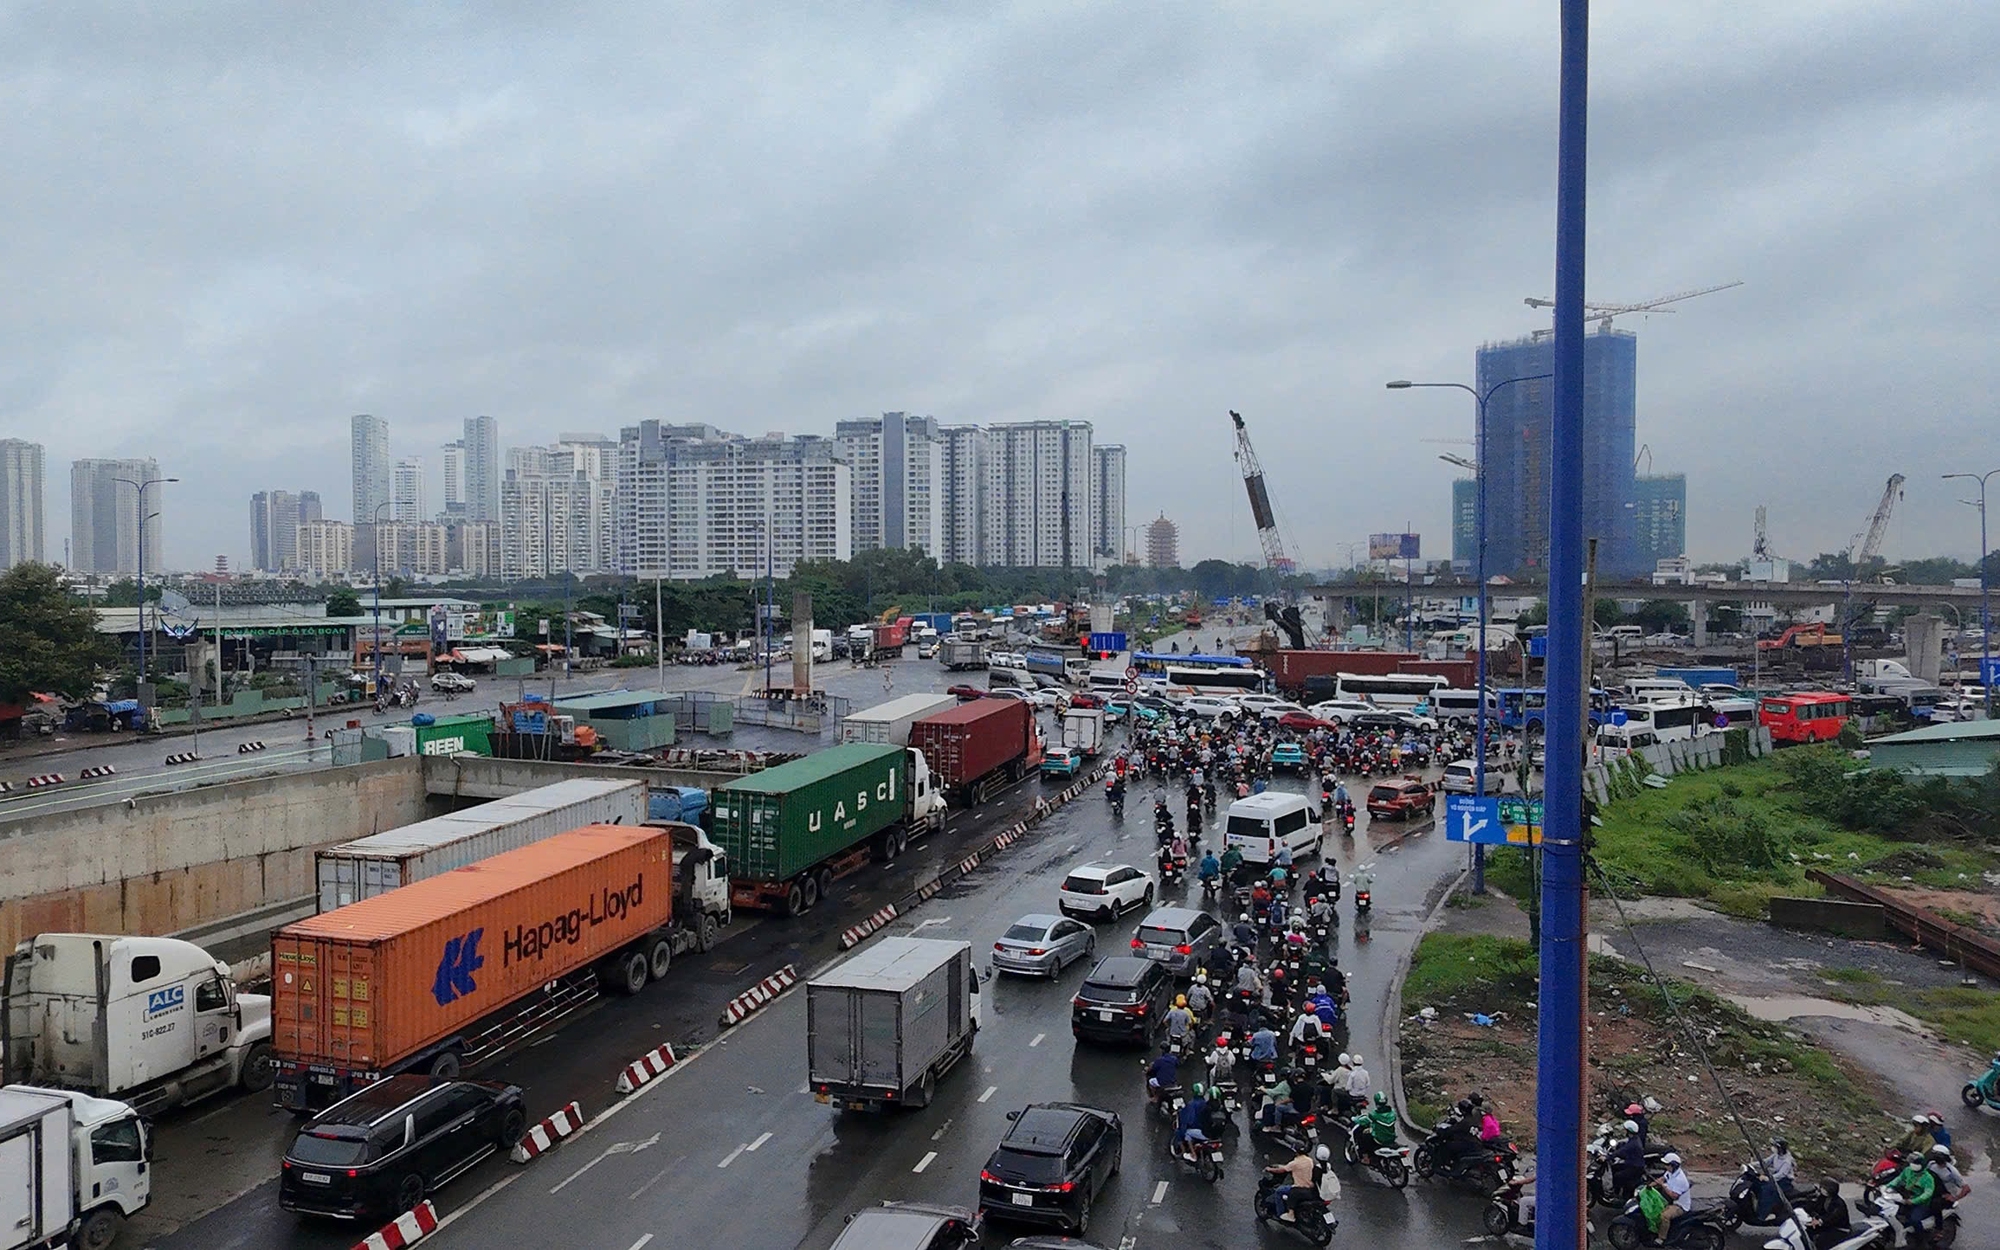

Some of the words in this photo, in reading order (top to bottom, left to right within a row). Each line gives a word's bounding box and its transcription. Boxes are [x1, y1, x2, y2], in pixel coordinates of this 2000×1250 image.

[423, 735, 464, 756] REEN
[504, 872, 643, 968] Hapag-Lloyd
[150, 985, 184, 1009] ALC
